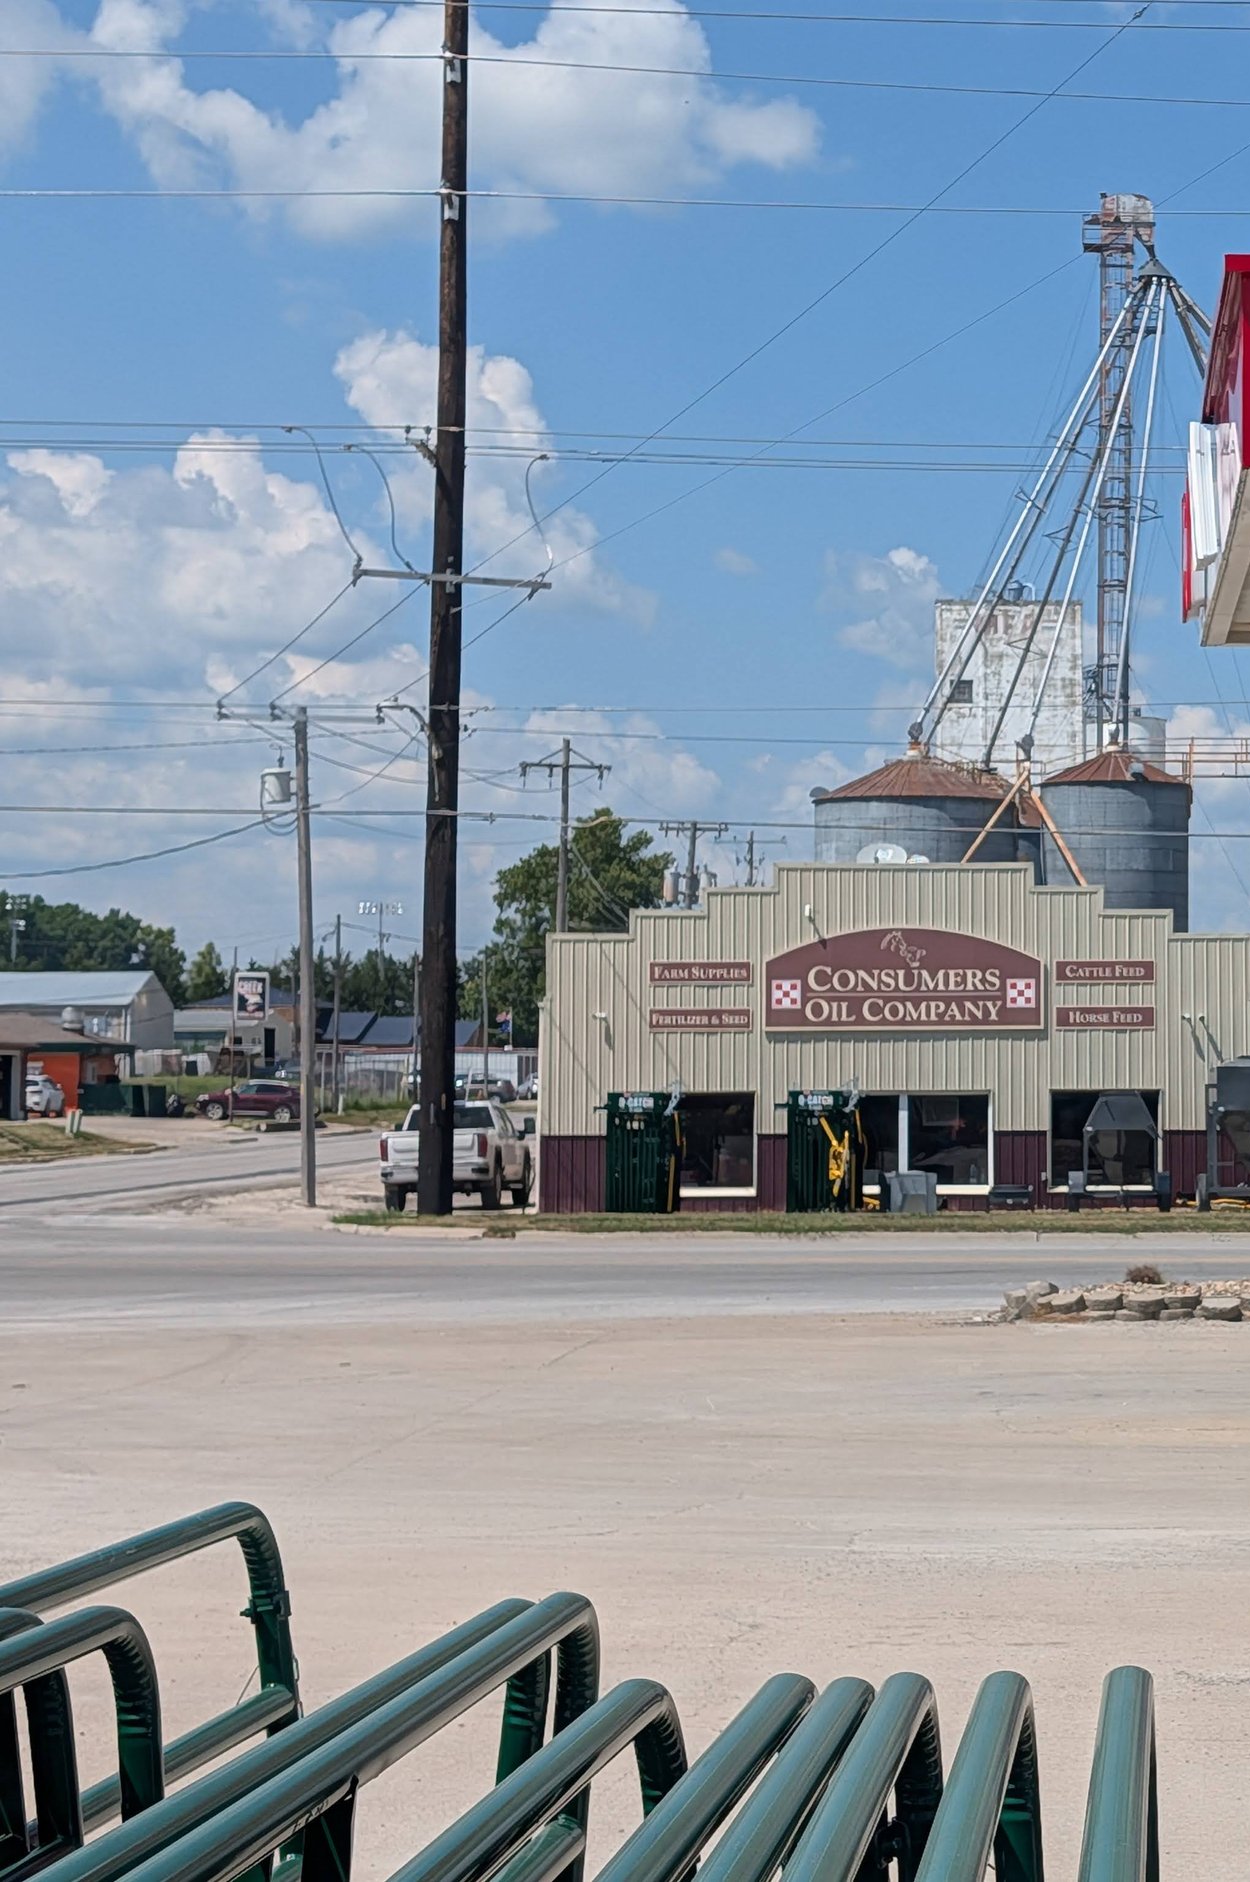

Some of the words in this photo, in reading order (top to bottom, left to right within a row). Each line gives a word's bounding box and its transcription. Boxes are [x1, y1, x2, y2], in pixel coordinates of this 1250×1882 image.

[654, 966, 689, 979] FARM
[691, 966, 747, 979] SUPPLIES
[1065, 965, 1112, 977] CATTLE
[1115, 965, 1145, 977] FEED
[807, 965, 1000, 992] CONSUMERS
[805, 998, 856, 1022] OIL
[862, 998, 1002, 1022] COMPANY
[652, 1013, 709, 1025] FERTILIZER
[711, 1015, 720, 1025] &
[721, 1013, 748, 1024] SEED
[1068, 1011, 1110, 1023] HORSE
[1112, 1011, 1143, 1023] FEED
